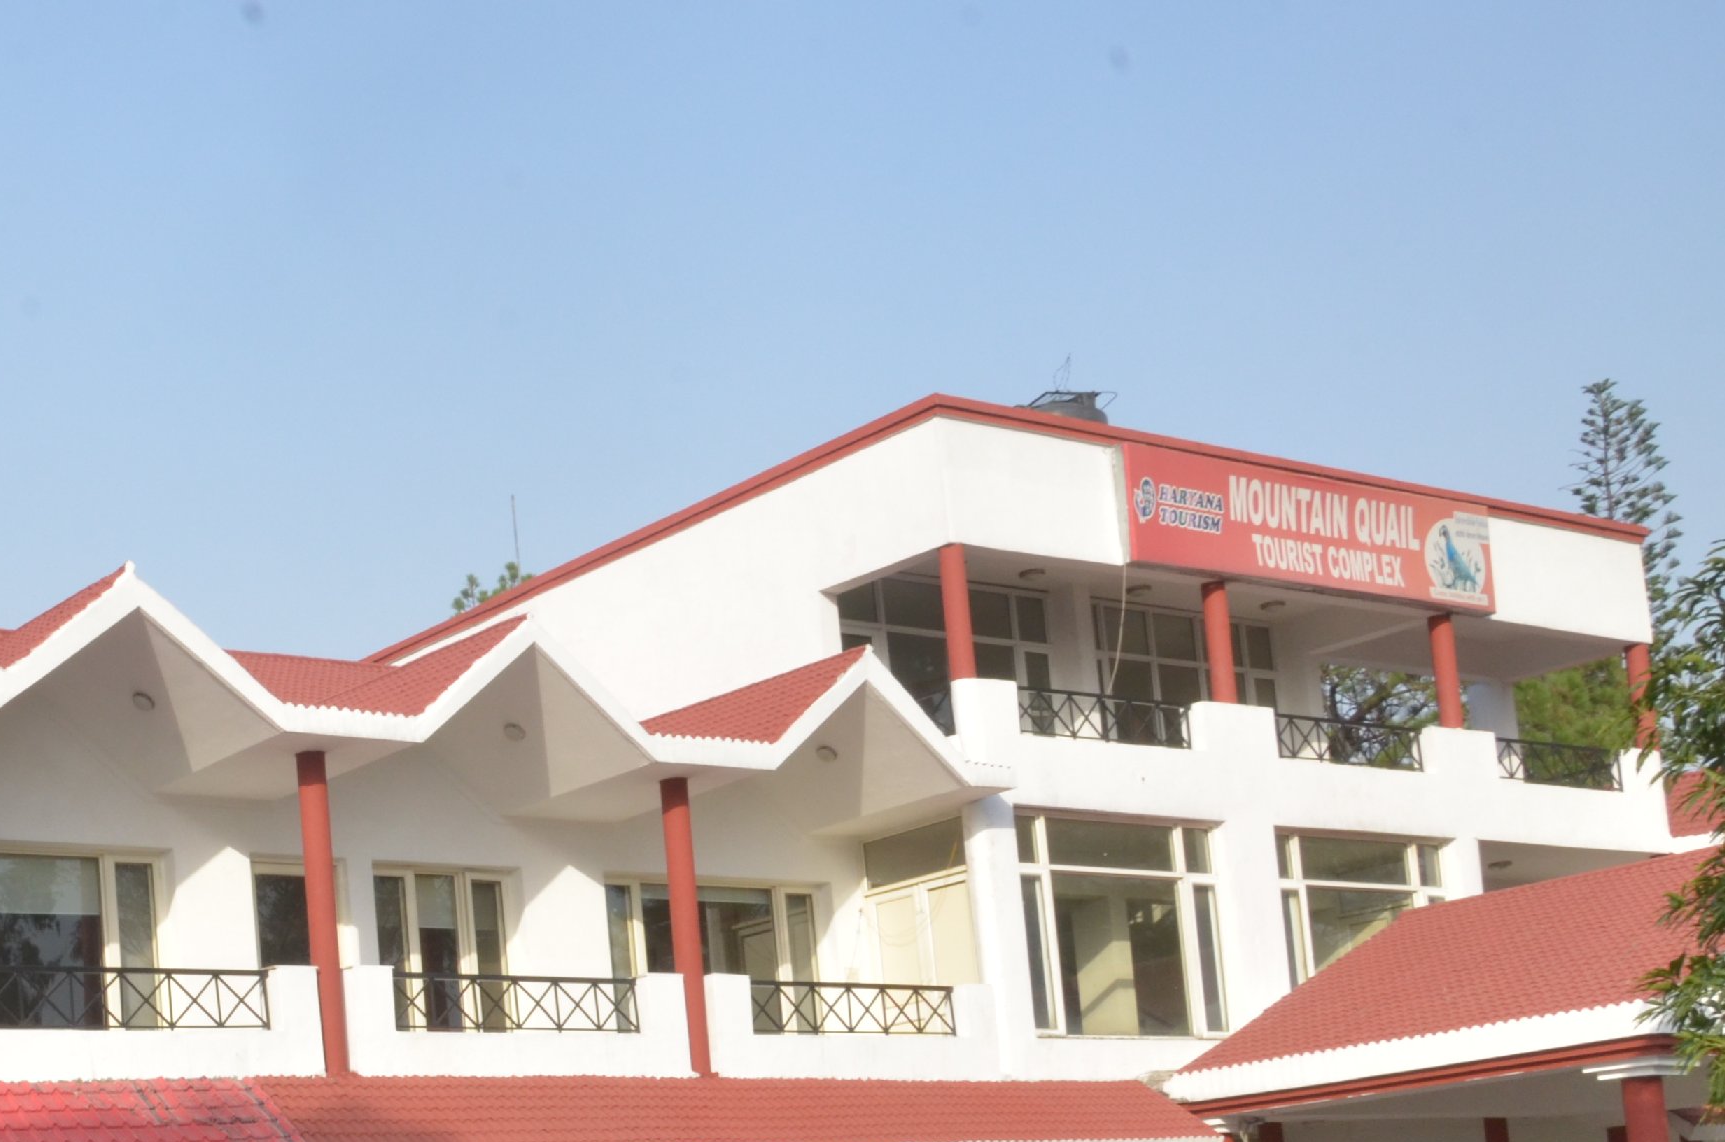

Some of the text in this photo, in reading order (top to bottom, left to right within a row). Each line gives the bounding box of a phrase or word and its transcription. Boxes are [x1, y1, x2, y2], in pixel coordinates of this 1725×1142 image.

[1159, 485, 1223, 512] HARYANA
[1229, 476, 1420, 551] MOUNTAIN QUAIL
[1159, 507, 1221, 532] TOURISM
[1252, 534, 1405, 588] TOURIST COMPLEX
